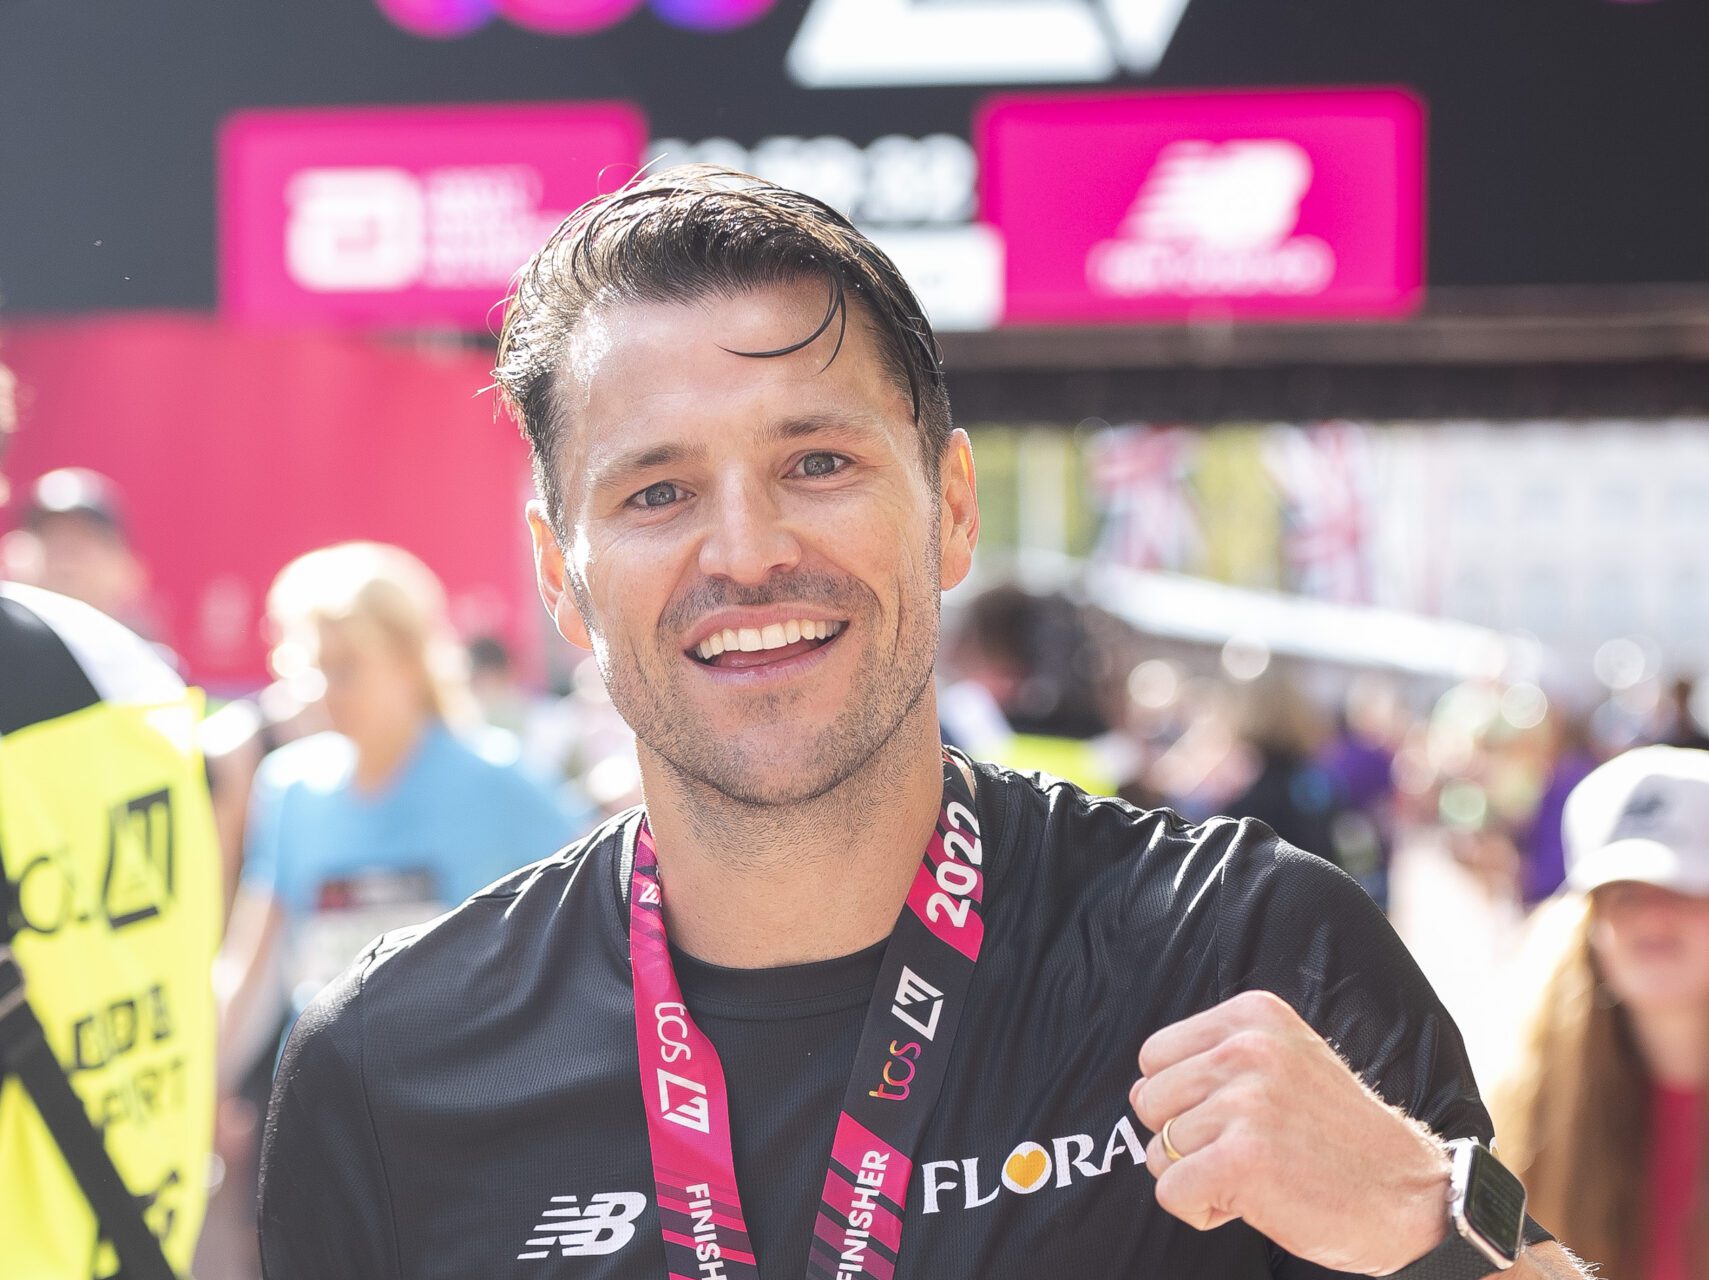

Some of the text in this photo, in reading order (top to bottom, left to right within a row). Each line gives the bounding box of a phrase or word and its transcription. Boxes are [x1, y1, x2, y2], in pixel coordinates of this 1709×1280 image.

[926, 801, 983, 928] 2022
[654, 1001, 692, 1063] tcs
[869, 1039, 922, 1101] tcs
[921, 1115, 1148, 1215] FLORA
